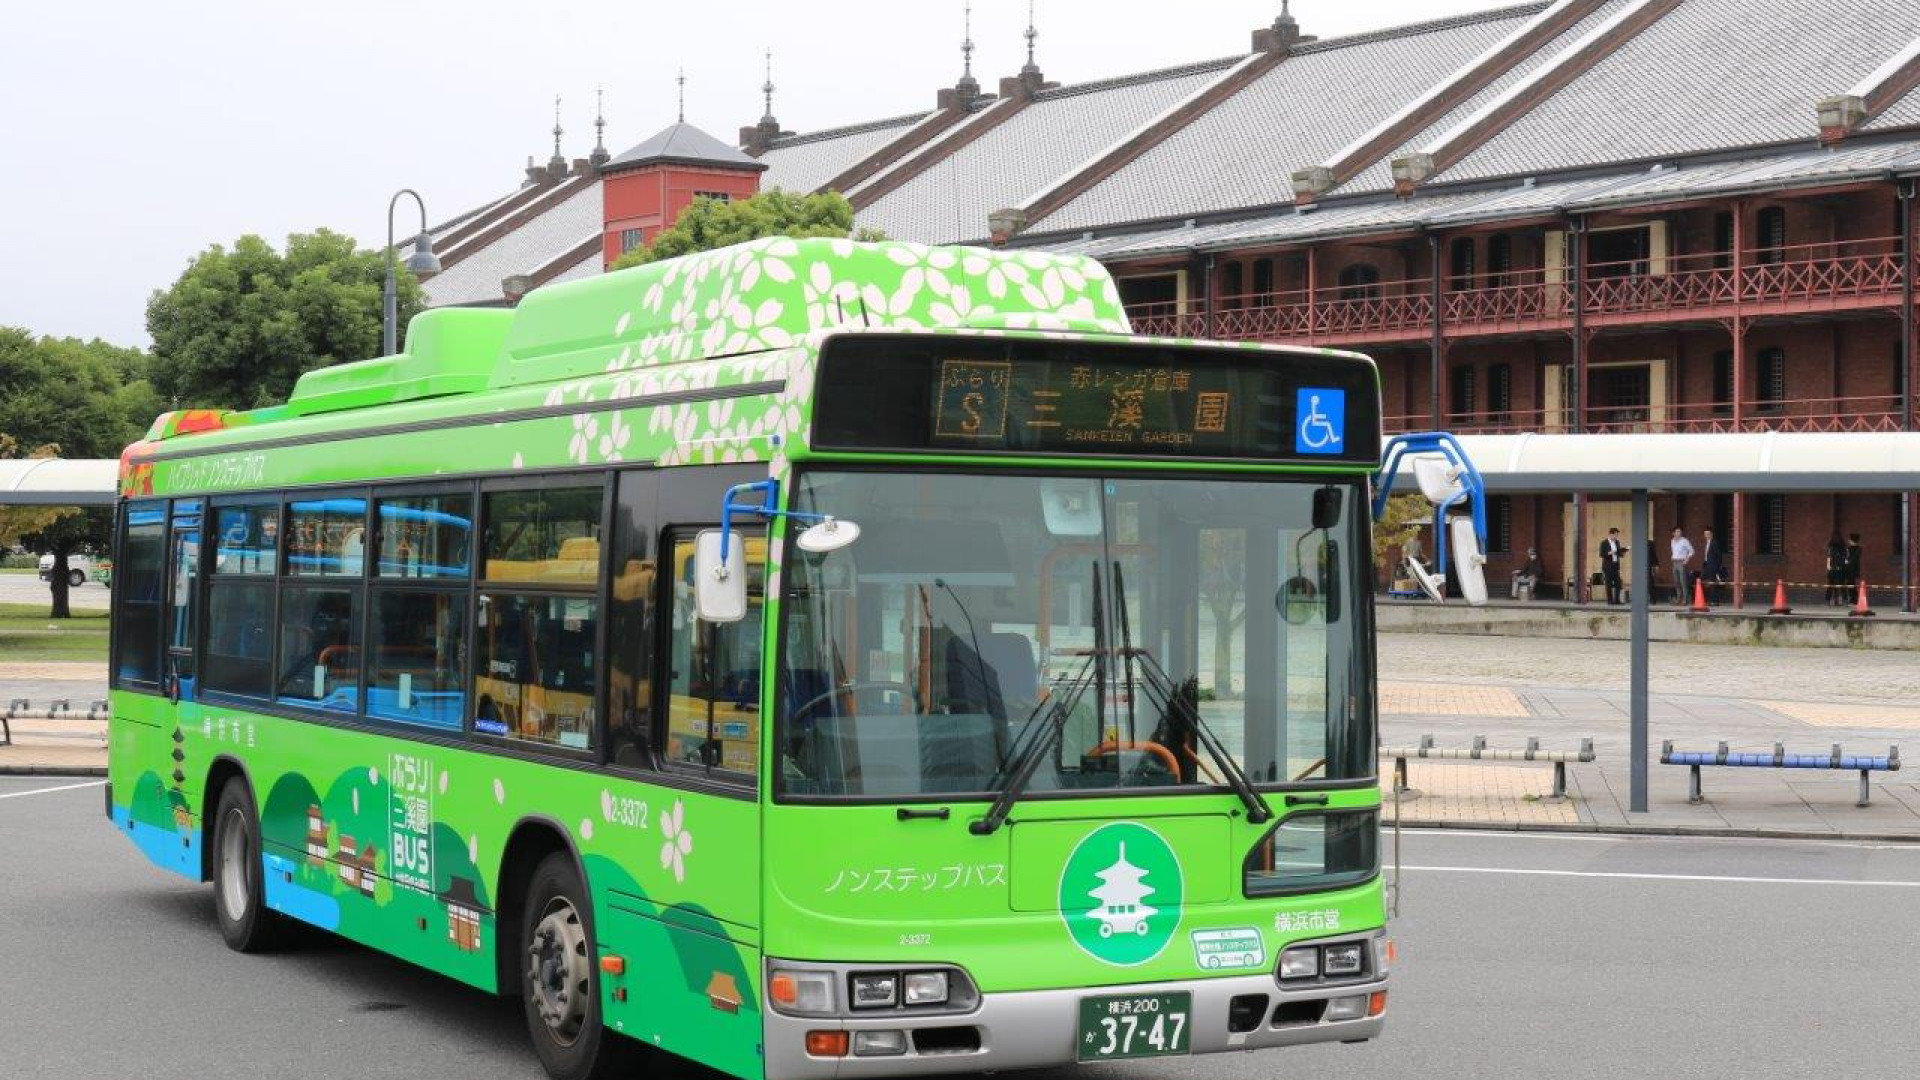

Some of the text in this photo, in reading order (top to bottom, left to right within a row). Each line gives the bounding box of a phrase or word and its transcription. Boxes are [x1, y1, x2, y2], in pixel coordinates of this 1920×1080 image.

[1070, 366, 1191, 392] 赤レンガ倉庫
[962, 392, 983, 430] S
[1065, 429, 1192, 444] SANKEIEN GARDEN
[392, 754, 429, 792] ぶらり
[611, 797, 648, 829] 2-3372
[393, 832, 429, 874] BUS
[824, 863, 1006, 893] ノンステップバス
[1274, 908, 1339, 932] 横浜市営
[900, 934, 931, 945] 2-3372
[1100, 1013, 1186, 1054] 37-47
